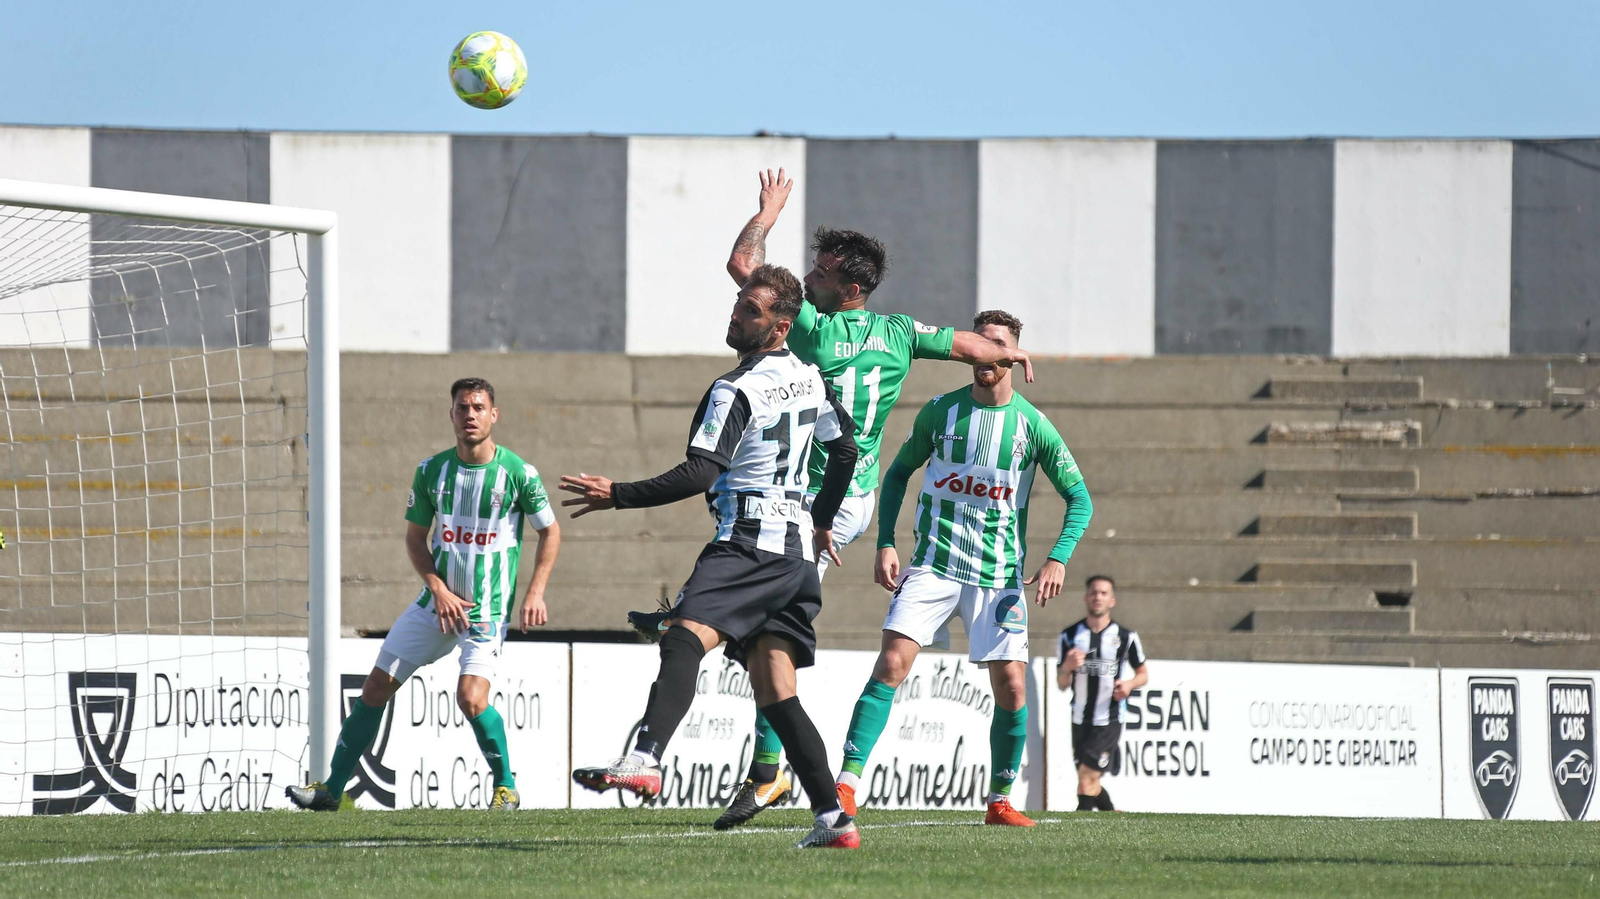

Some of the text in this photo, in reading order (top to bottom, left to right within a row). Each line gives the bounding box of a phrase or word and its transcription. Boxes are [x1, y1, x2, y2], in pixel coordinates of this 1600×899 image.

[764, 386, 790, 405] PITO
[833, 366, 881, 439] 11
[761, 406, 819, 486] 17
[746, 498, 765, 516] LA
[931, 657, 992, 718] italiana
[1473, 688, 1515, 715] PANDA
[1552, 688, 1591, 715] PANDA
[154, 672, 301, 738] Diputación
[410, 675, 541, 738] Dipución
[1124, 689, 1210, 731] SSAN
[707, 717, 736, 740] 1933
[920, 721, 946, 743] 1933
[1482, 717, 1510, 741] CARS
[1560, 717, 1587, 741] CARS
[1124, 740, 1211, 777] NCESOL
[1250, 737, 1418, 767] CAMPO DE GIBRALTAR
[152, 757, 274, 812] de Cádiz
[410, 757, 439, 808] de
